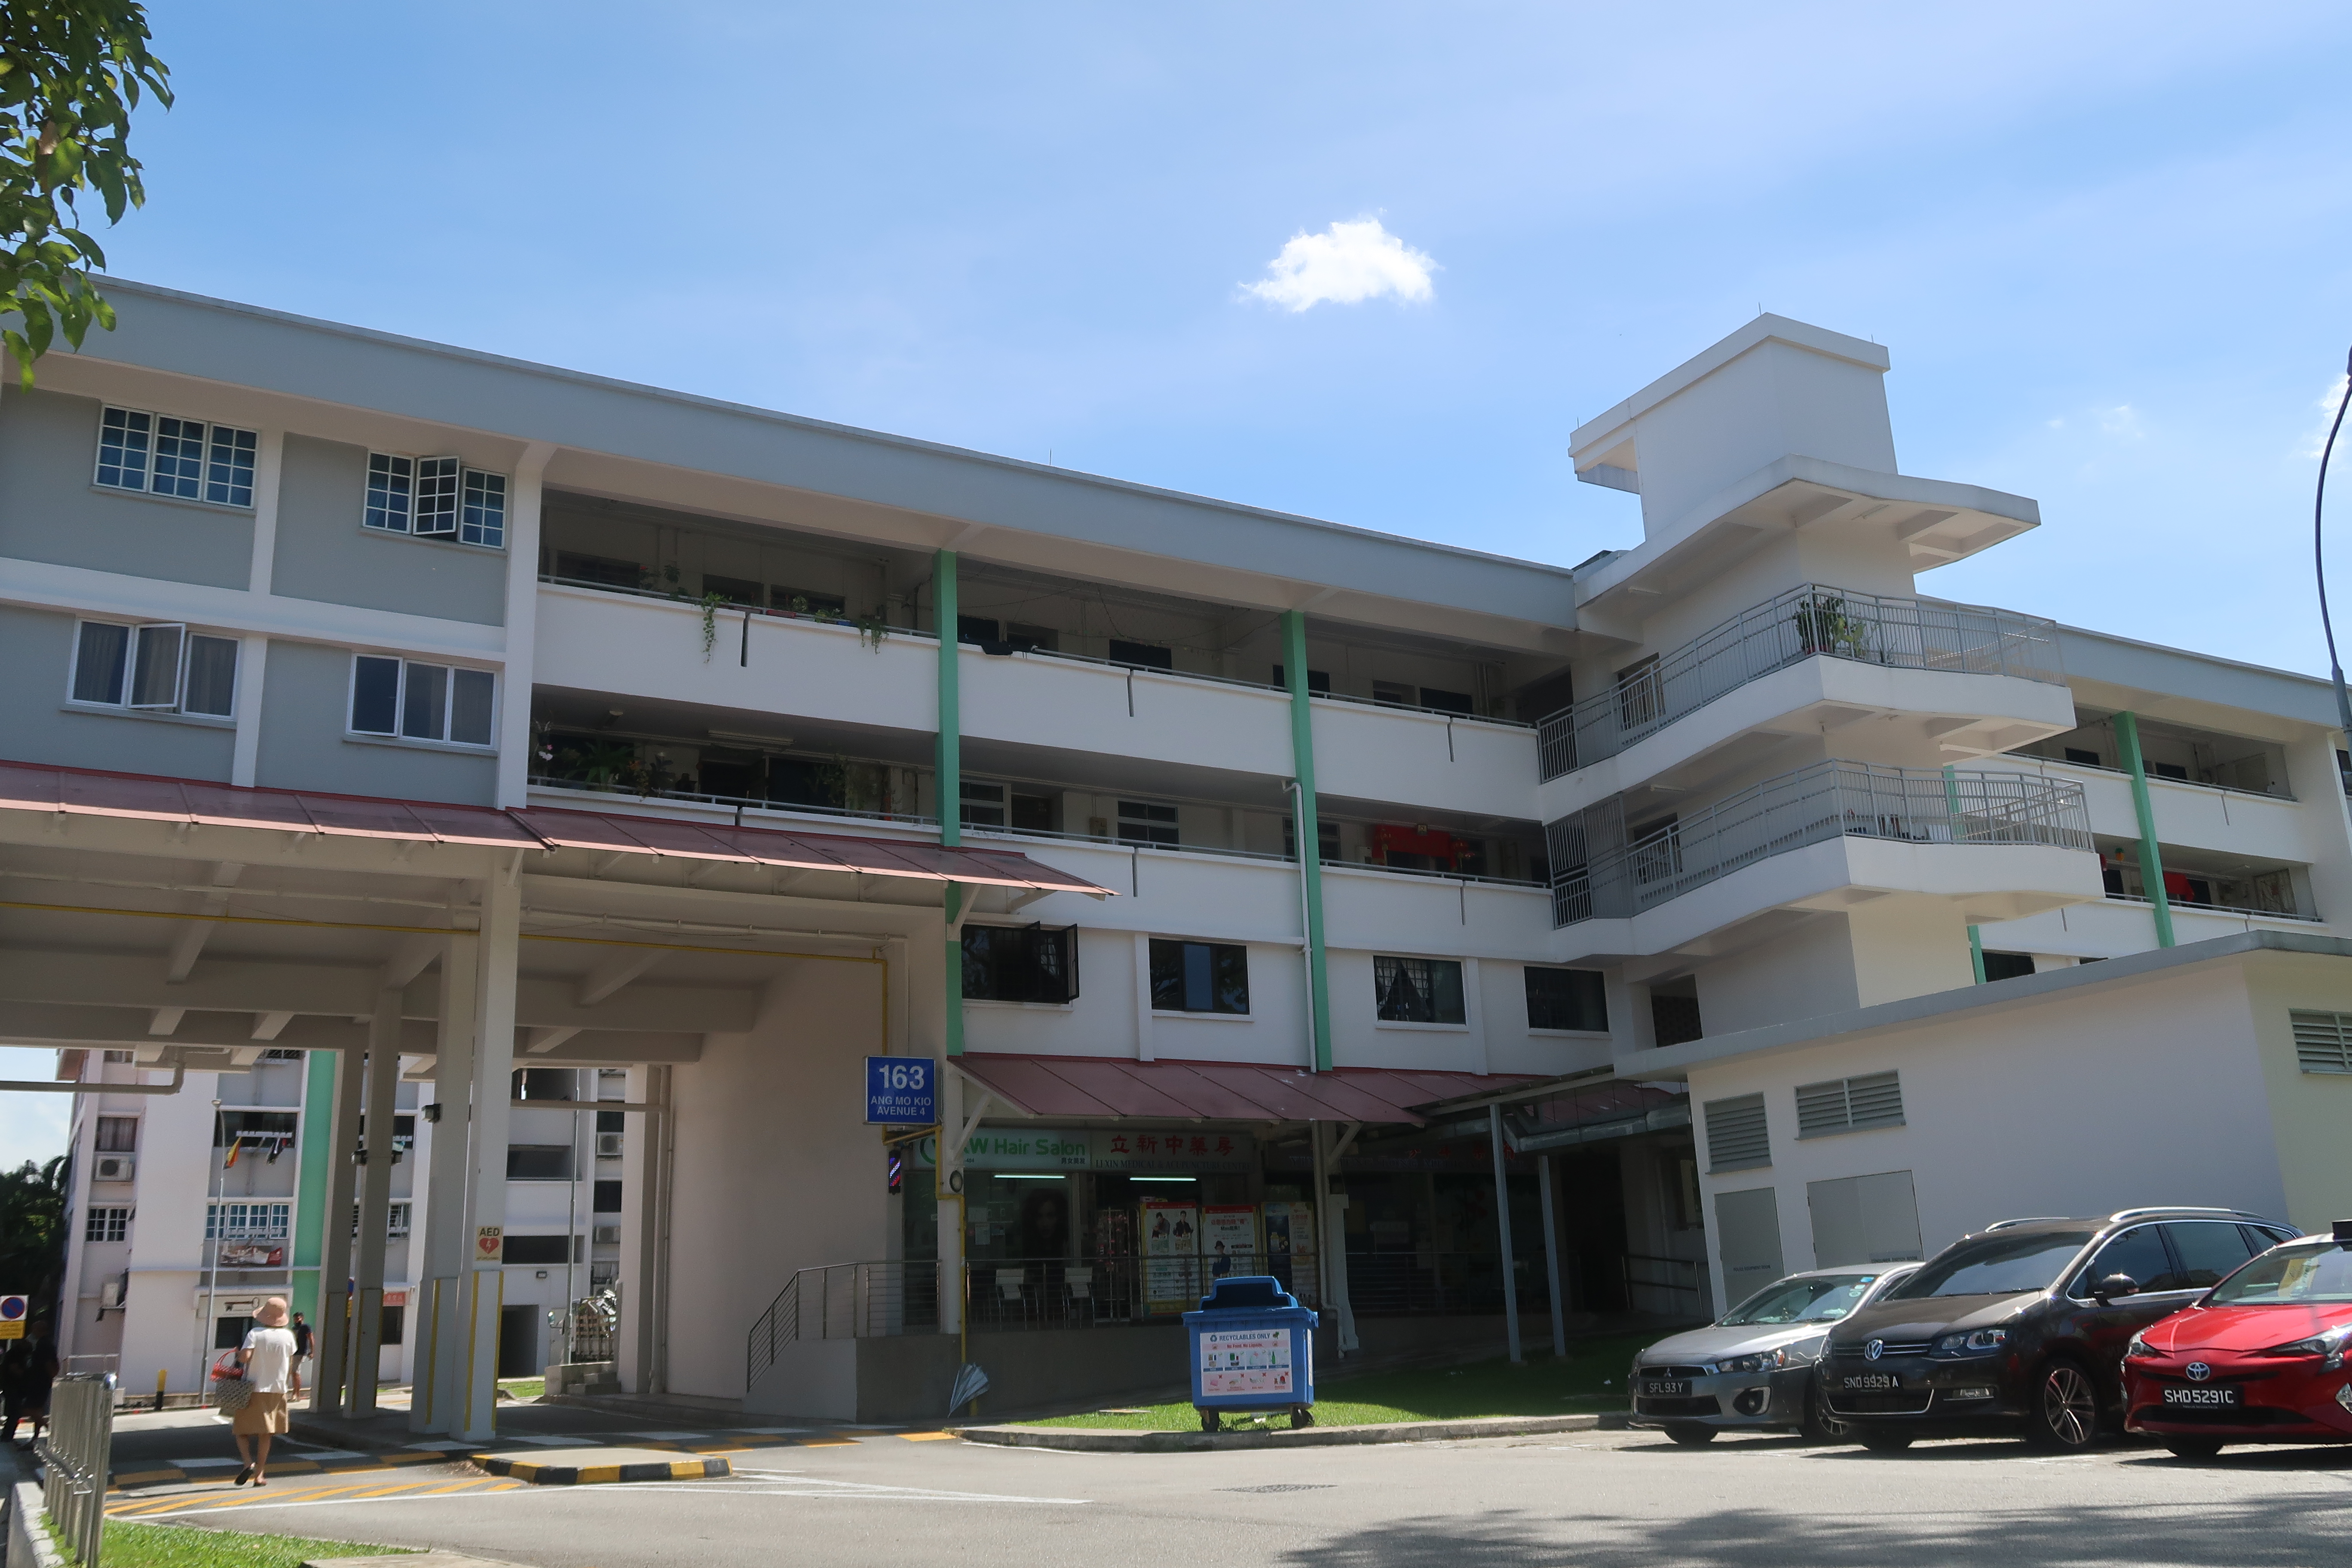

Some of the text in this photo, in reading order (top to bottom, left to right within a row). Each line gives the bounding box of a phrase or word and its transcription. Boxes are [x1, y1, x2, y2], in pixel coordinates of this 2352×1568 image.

[879, 1064, 924, 1090] 163
[871, 1096, 931, 1106] ANG MO KIO
[877, 1106, 925, 1116] AVENUE 4
[995, 1138, 1030, 1155] Hair
[1036, 1139, 1086, 1156] Salon
[1096, 1160, 1252, 1171] LI XIN MEDICAL & ACUPUNCTURE CENTRE
[1379, 1157, 1418, 1168] TONG
[1423, 1159, 1484, 1170] MEDICAL
[479, 1228, 499, 1237] AED
